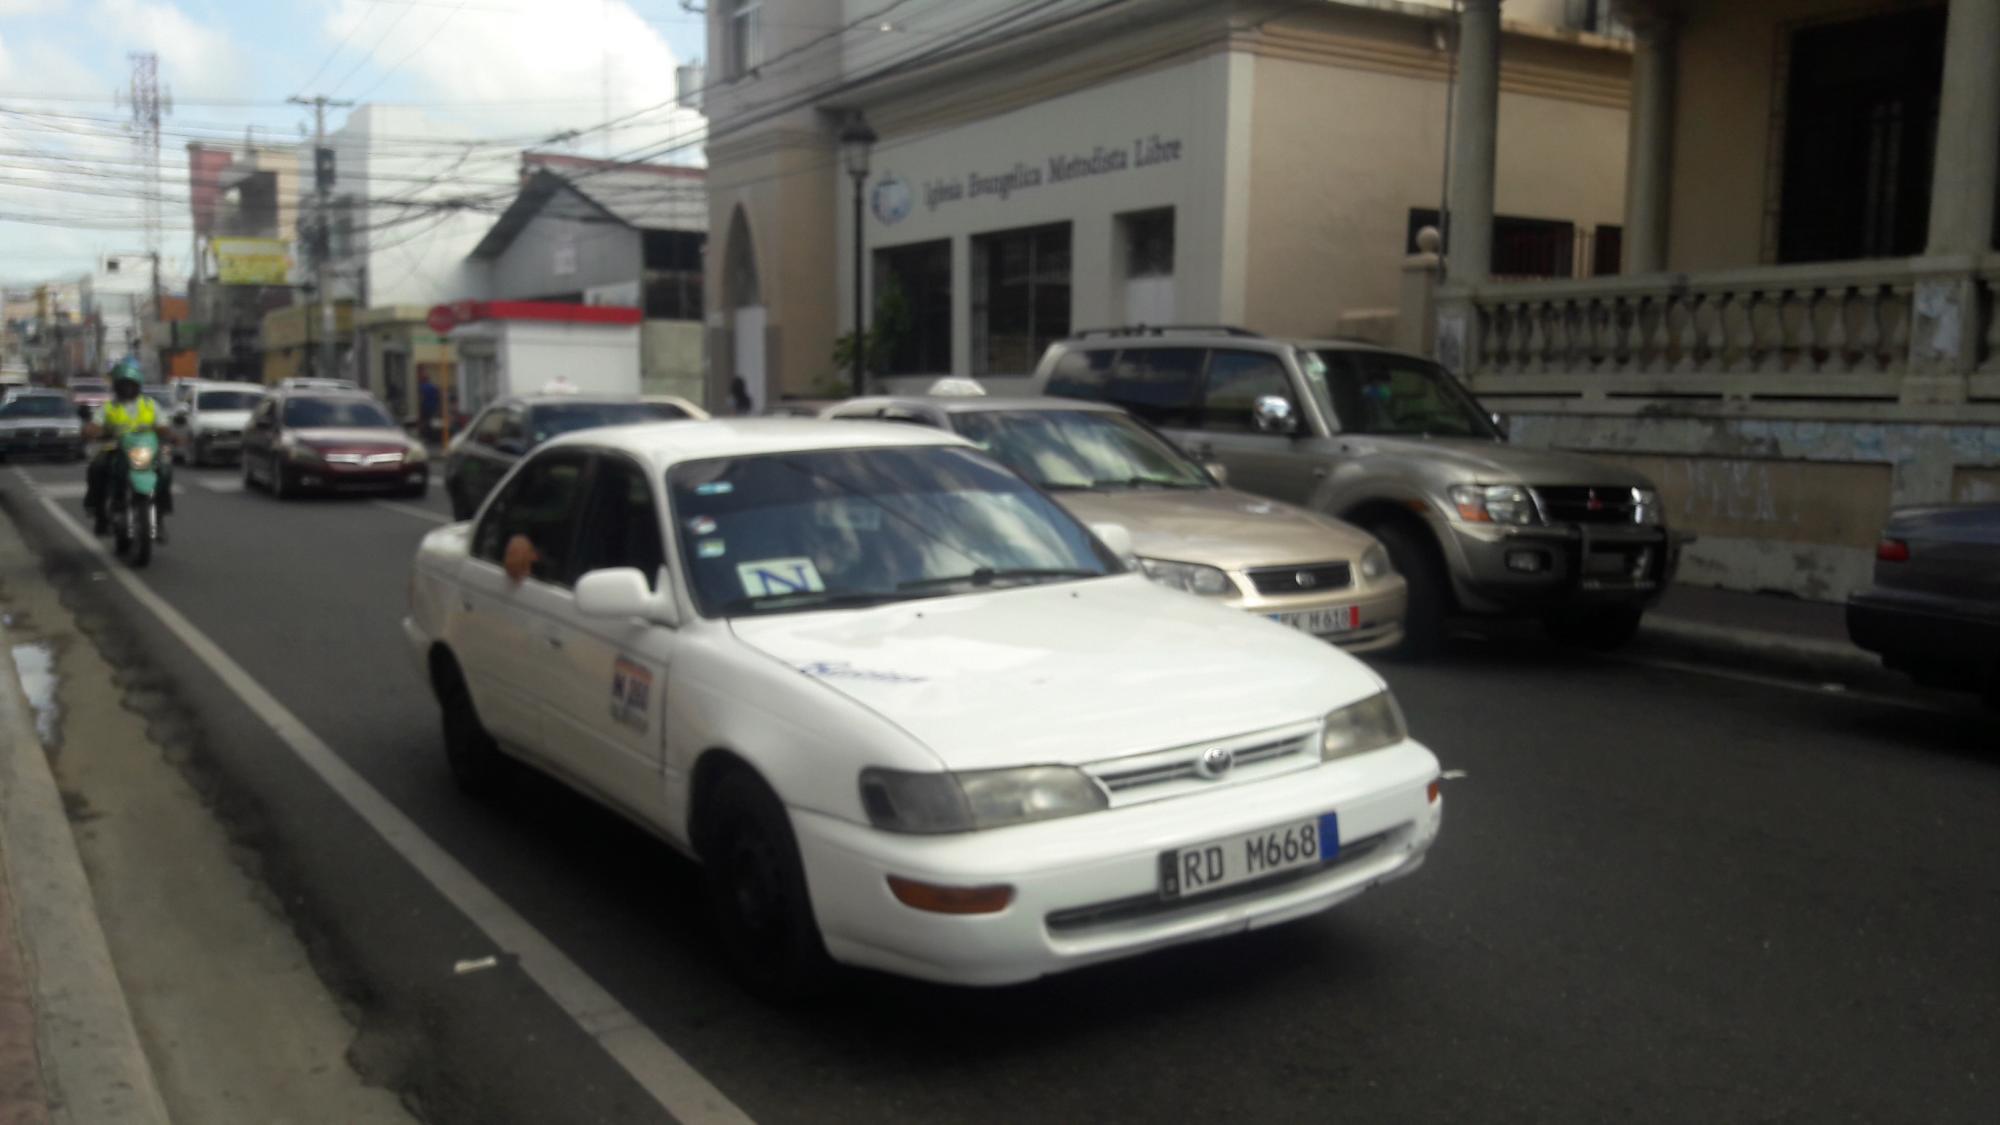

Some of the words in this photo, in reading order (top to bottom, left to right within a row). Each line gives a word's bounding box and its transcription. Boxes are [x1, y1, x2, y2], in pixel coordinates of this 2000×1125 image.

[1047, 146, 1127, 184] Metodista
[1132, 134, 1182, 168] Libre
[747, 564, 810, 594] N
[1184, 845, 1224, 889] RD
[1246, 825, 1317, 873] M668
